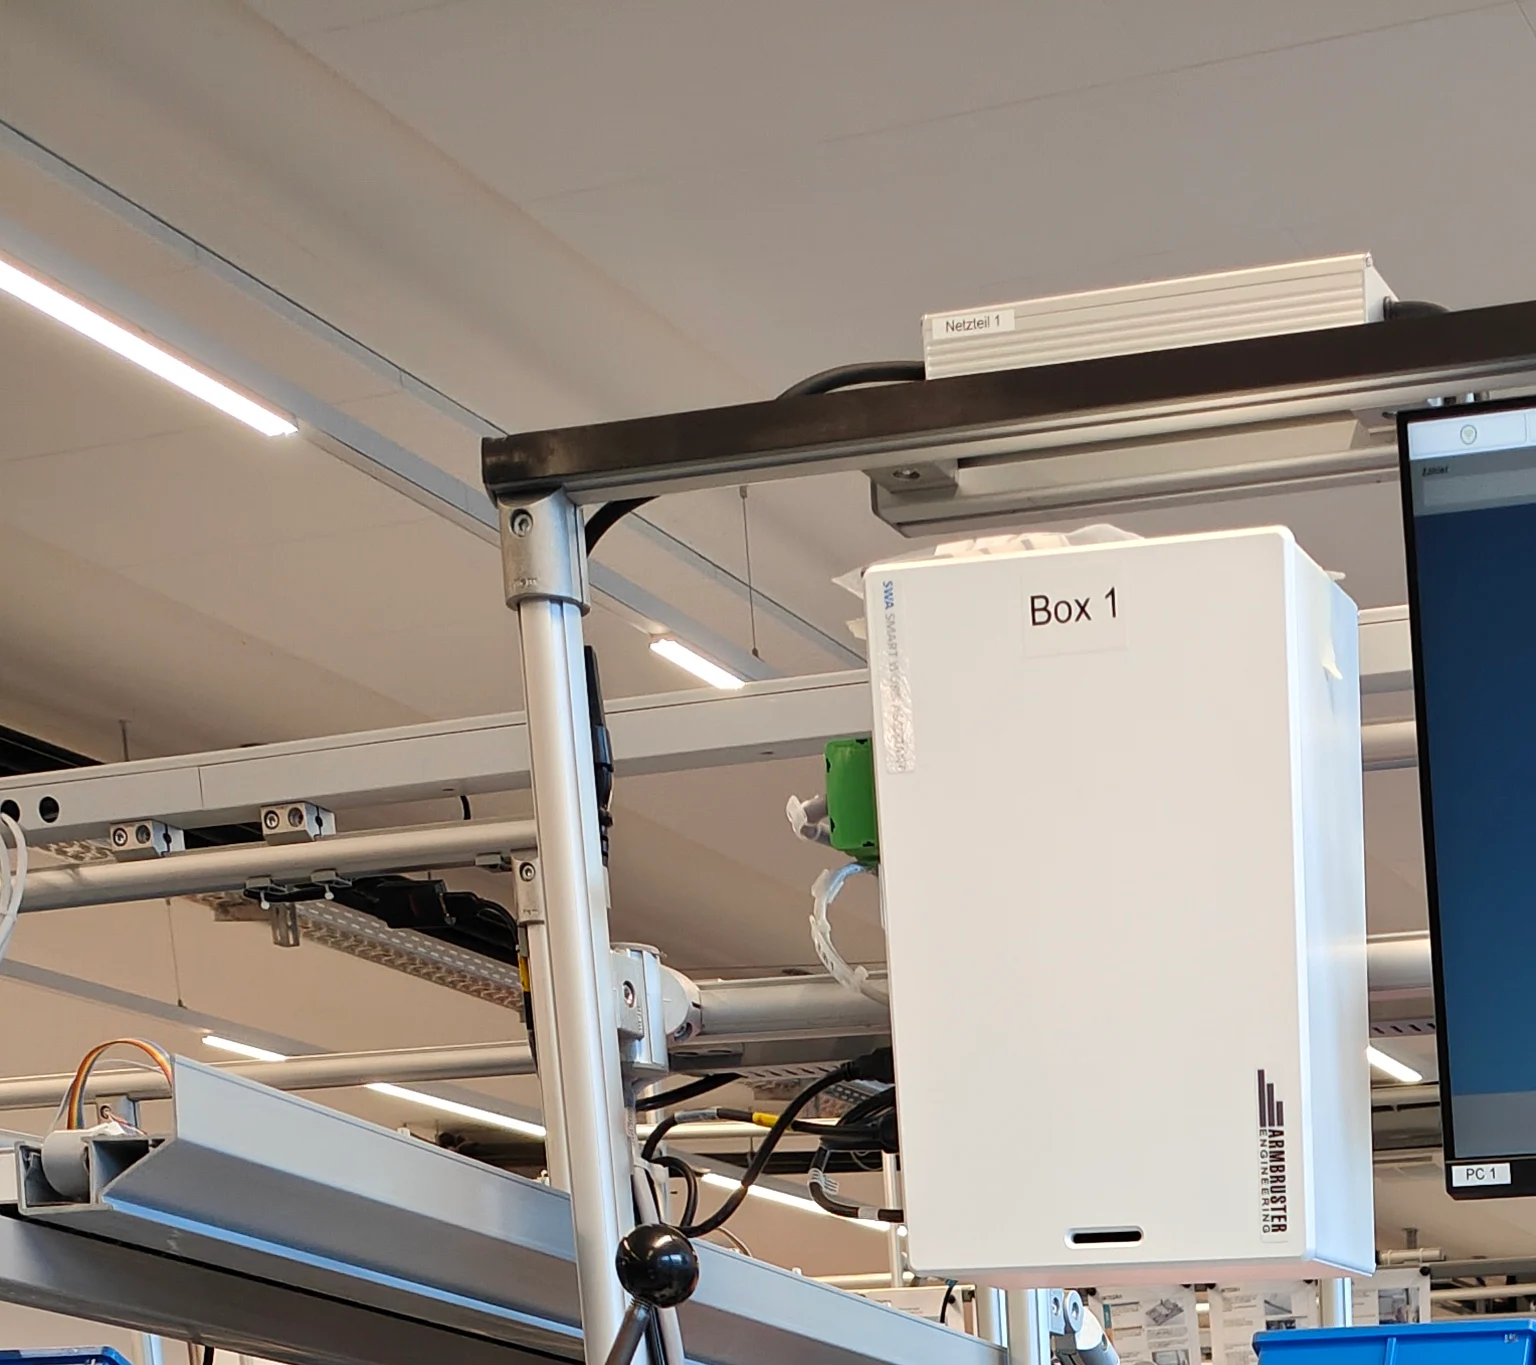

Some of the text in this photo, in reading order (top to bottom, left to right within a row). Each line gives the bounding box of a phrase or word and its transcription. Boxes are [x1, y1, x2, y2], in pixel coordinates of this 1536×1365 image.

[945, 315, 1001, 333] Netzteil 1
[883, 581, 894, 609] SWA
[1030, 587, 1118, 627] Box 1
[1258, 1128, 1271, 1235] ENGINEERING
[1268, 1127, 1288, 1234] ARMBRUSTER
[1465, 1166, 1497, 1182] PC 1
